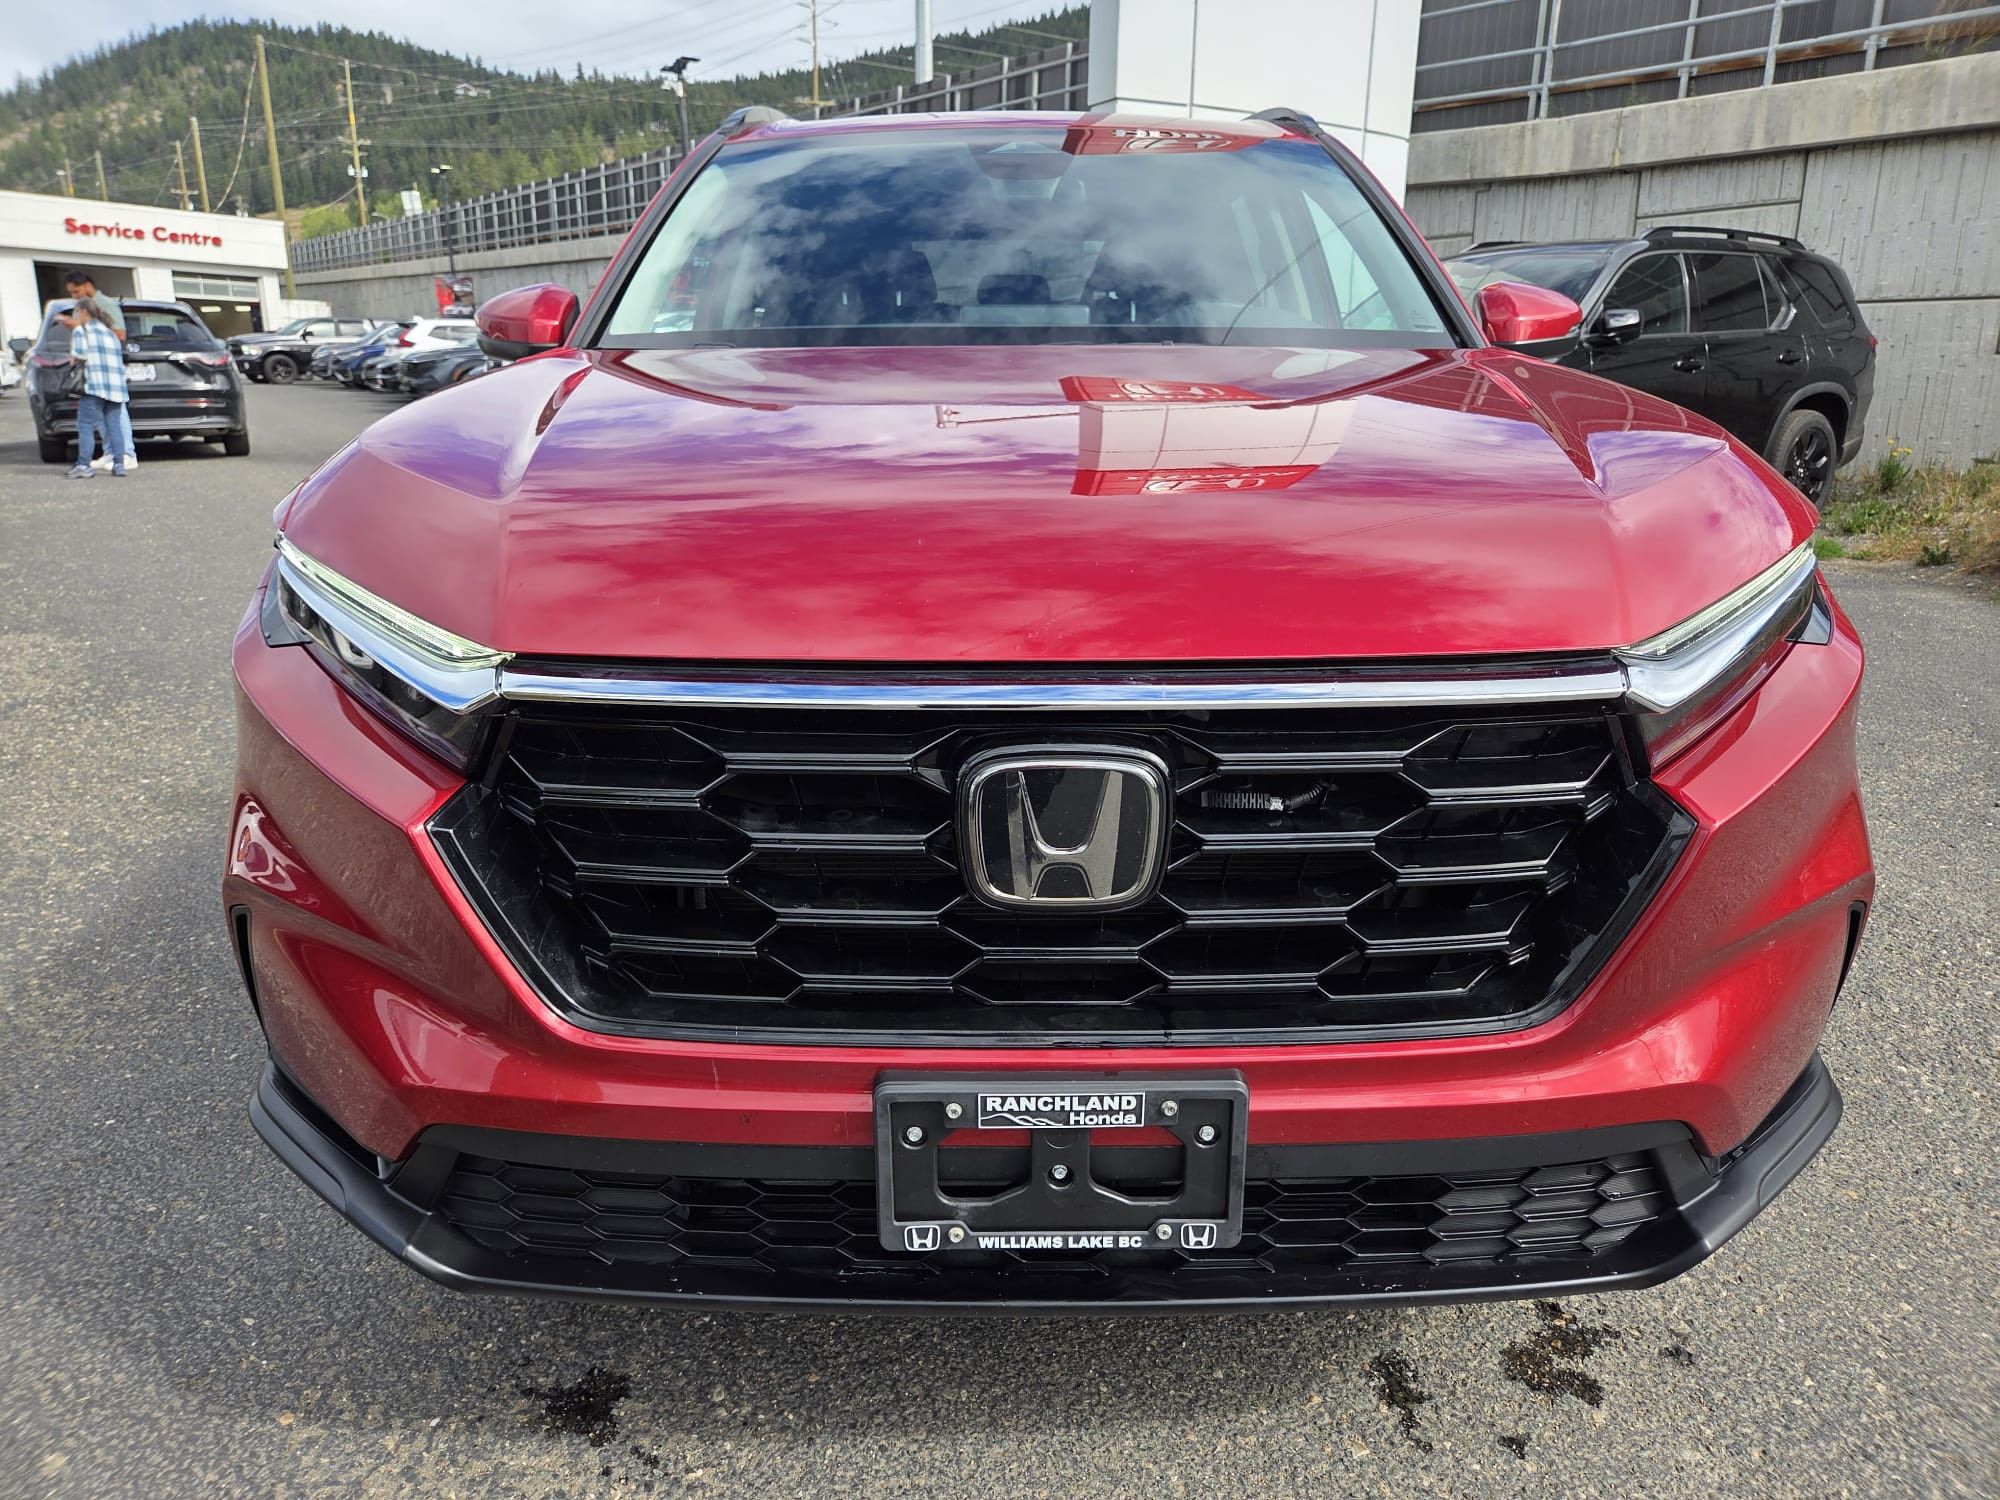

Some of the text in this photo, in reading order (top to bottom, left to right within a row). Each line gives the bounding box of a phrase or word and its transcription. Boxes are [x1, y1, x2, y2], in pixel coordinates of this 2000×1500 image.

[64, 217, 223, 247] Service Centre
[986, 1096, 1137, 1112] RANCHLAND
[1069, 1112, 1137, 1125] Honda
[978, 1236, 1142, 1249] WILLIAMS LAKE BC
